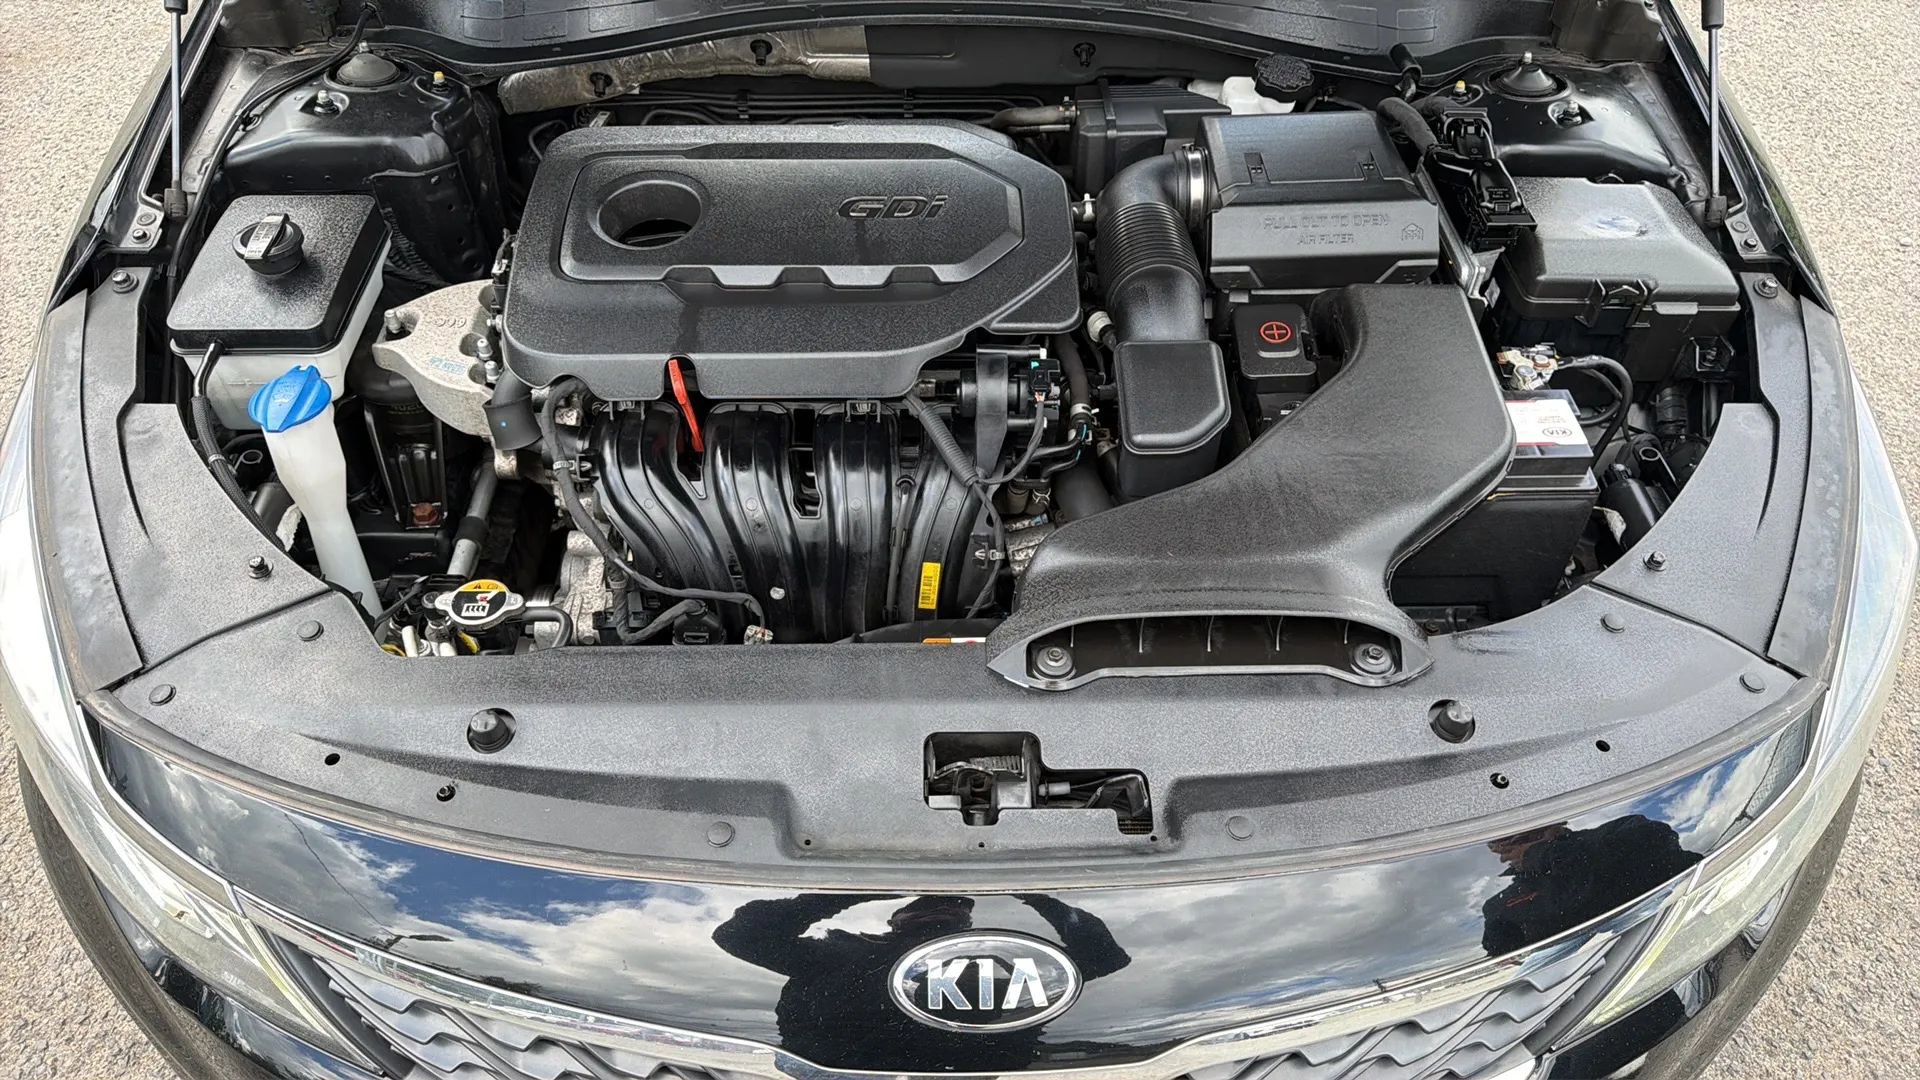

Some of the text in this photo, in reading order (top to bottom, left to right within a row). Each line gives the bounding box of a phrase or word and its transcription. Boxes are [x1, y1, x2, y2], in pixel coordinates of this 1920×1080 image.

[837, 195, 949, 219] GDi
[1264, 213, 1390, 230] PULL OUT TO OPEN
[1297, 233, 1355, 245] AIR FILTER
[925, 958, 1049, 1010] KIA
